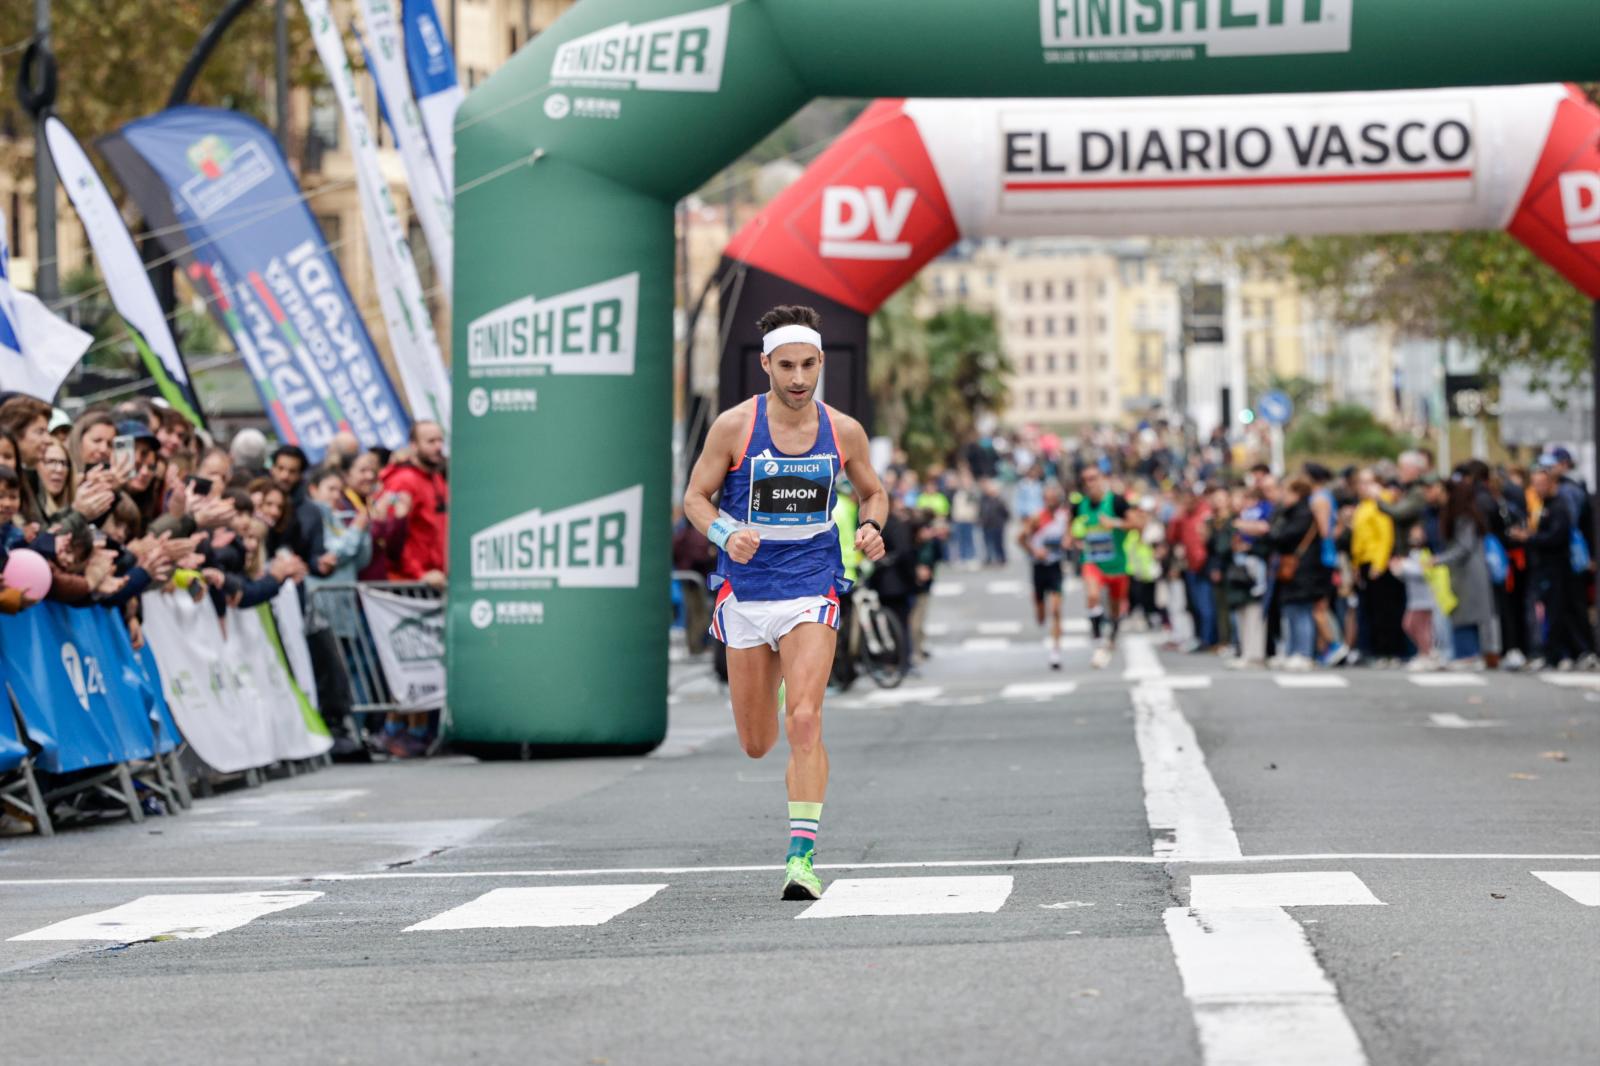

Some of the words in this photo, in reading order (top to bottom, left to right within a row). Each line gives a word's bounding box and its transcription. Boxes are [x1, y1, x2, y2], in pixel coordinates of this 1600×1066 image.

[1054, 0, 1322, 39] FINIS
[559, 27, 711, 74] FINISHER
[1004, 131, 1065, 174] EL
[1080, 126, 1272, 172] DIARIO
[1286, 119, 1471, 166] VASCO
[821, 185, 918, 242] DV
[1558, 169, 1600, 226] D
[473, 298, 622, 359] FINISHER
[783, 463, 820, 473] ZURICH
[772, 489, 817, 500] SIMON
[786, 503, 797, 512] 41
[476, 511, 626, 571] FINISHER
